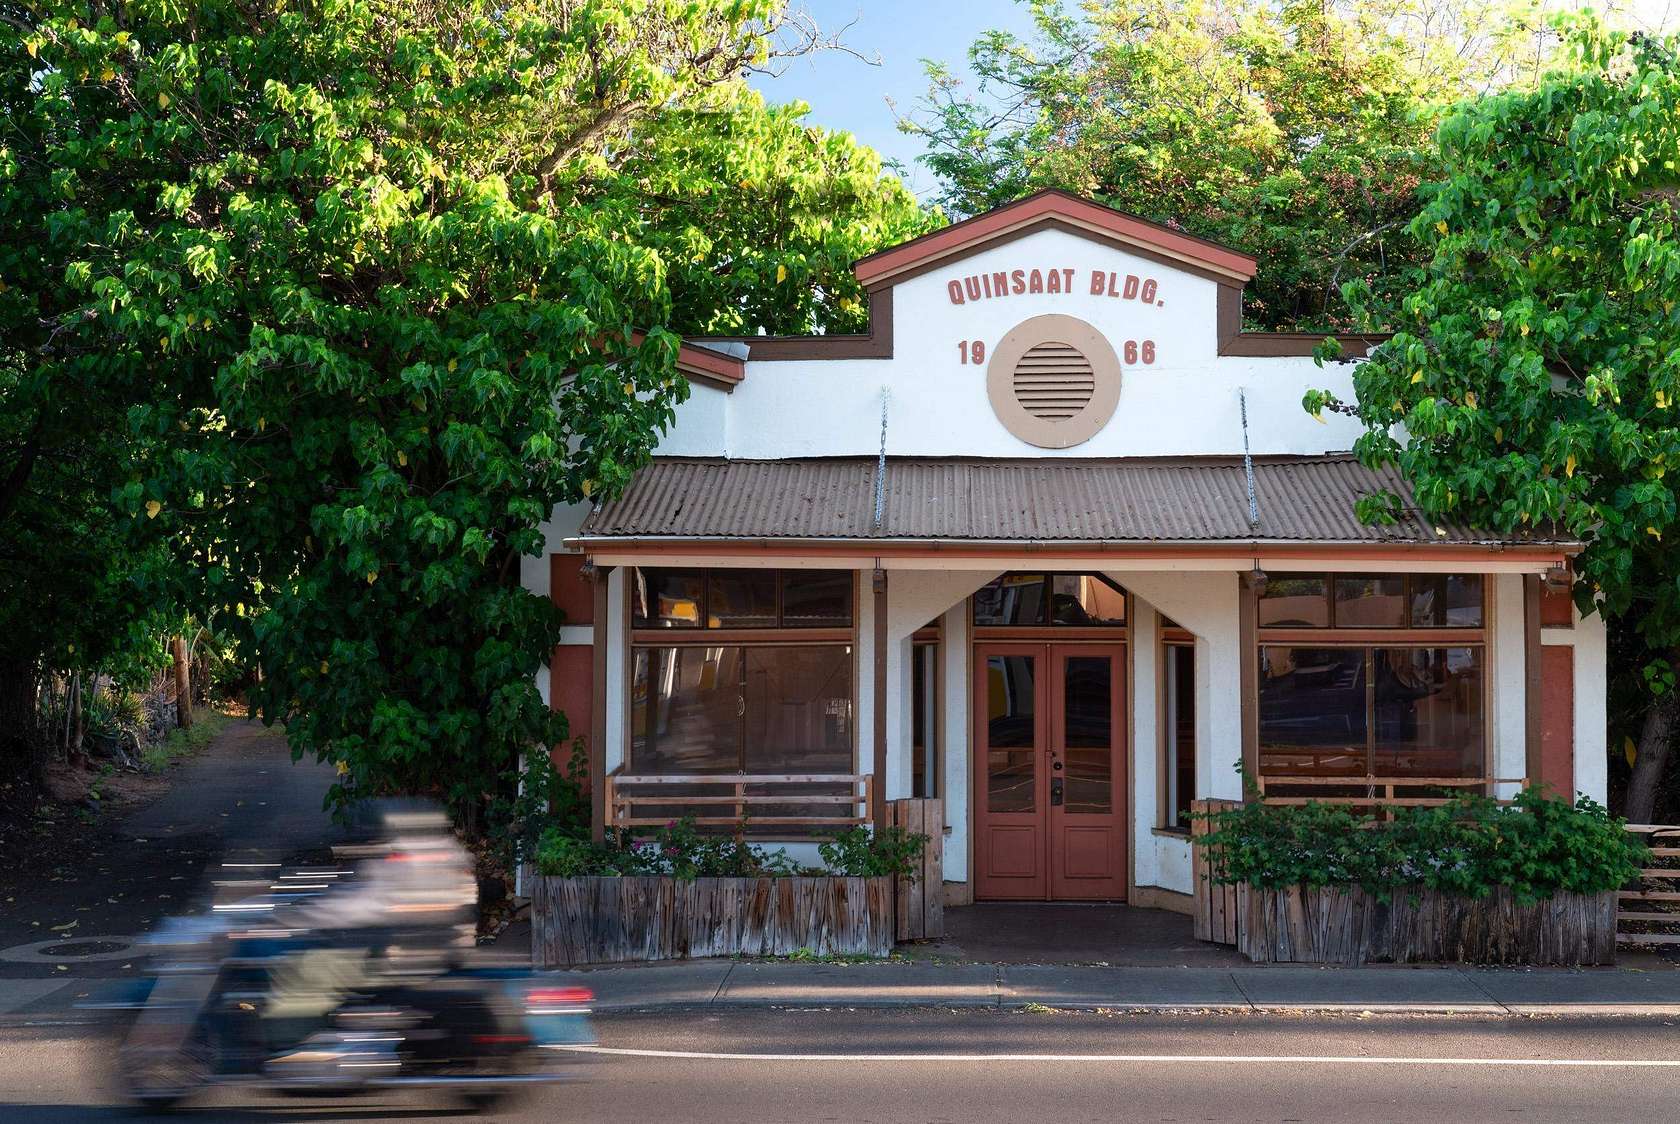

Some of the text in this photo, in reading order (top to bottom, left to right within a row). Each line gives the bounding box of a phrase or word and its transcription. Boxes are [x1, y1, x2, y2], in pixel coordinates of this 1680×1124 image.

[947, 268, 1165, 307] QUINSAAT BLDG.
[958, 340, 1155, 365] 19 66
